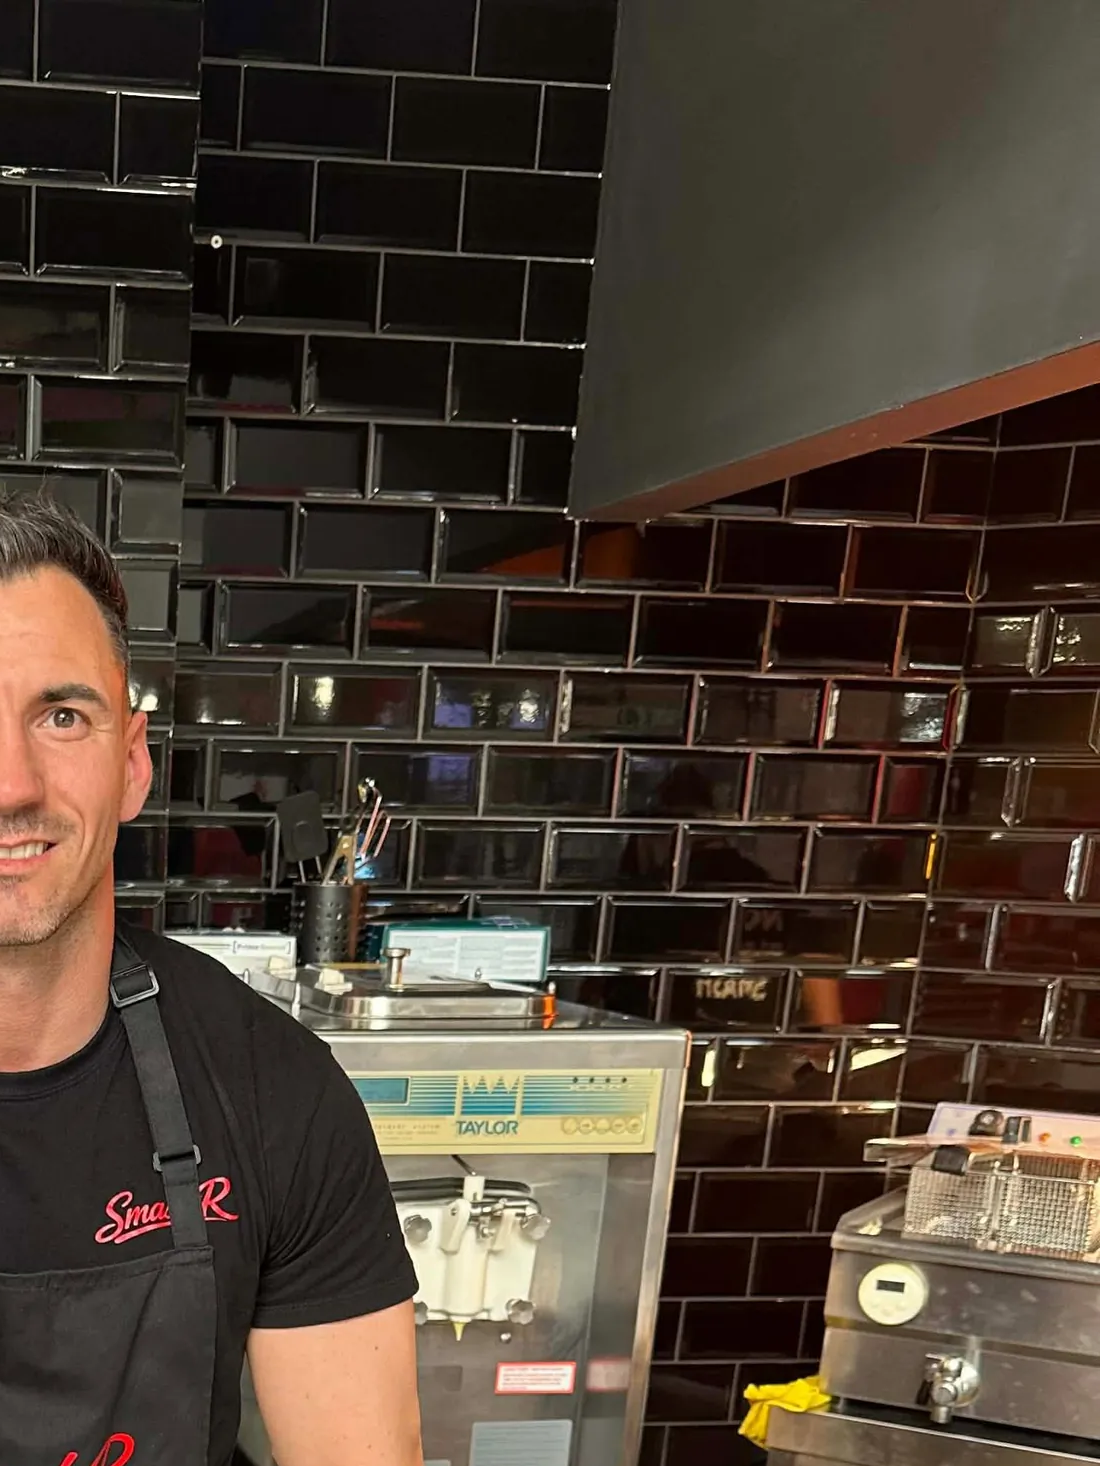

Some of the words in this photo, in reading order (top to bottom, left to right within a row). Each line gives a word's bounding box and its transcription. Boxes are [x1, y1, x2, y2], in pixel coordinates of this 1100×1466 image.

[456, 1120, 519, 1136] TAYLOR
[95, 1190, 172, 1244] Sma
[198, 1176, 239, 1221] R
